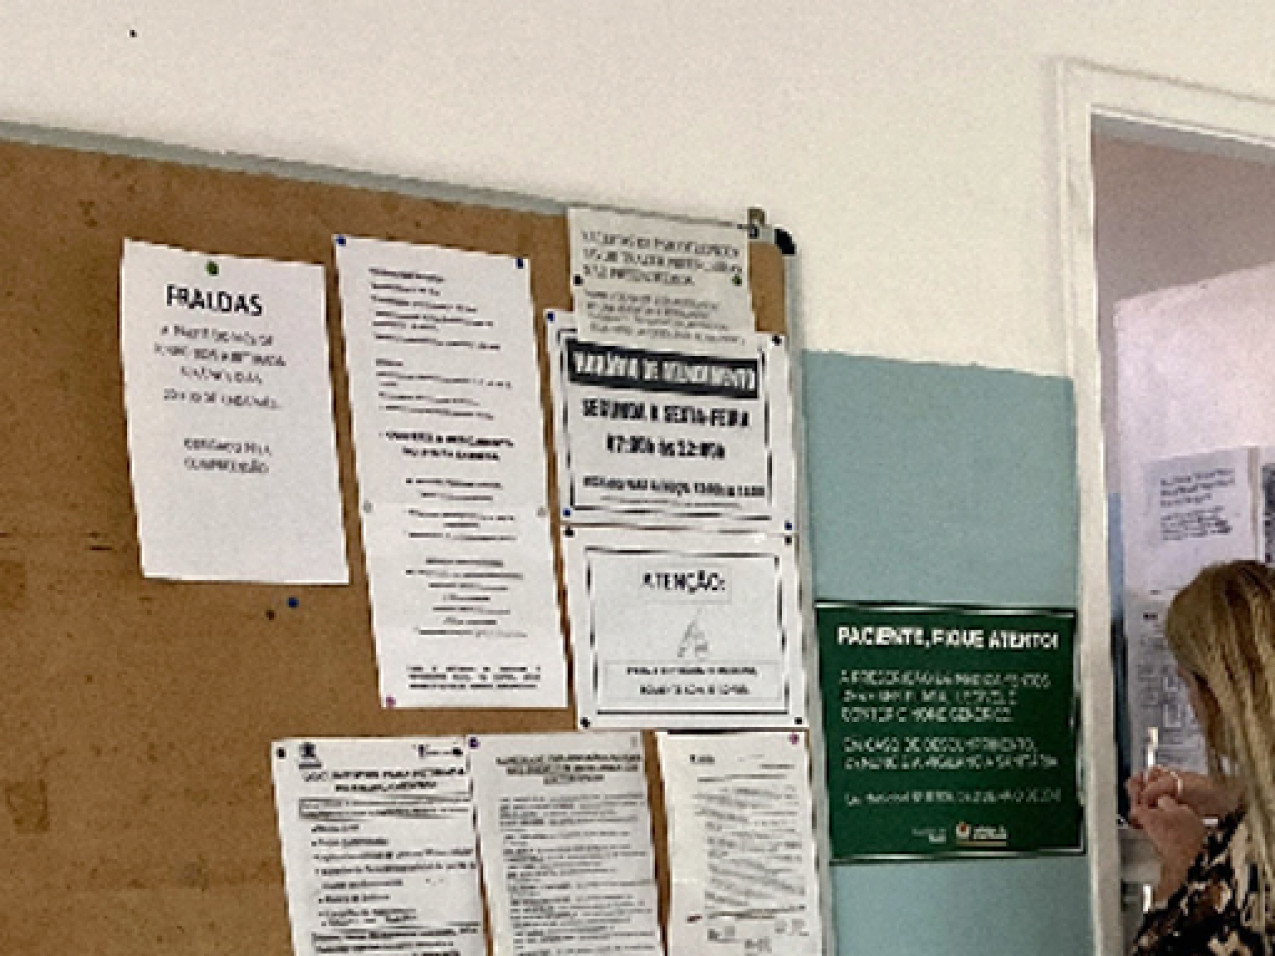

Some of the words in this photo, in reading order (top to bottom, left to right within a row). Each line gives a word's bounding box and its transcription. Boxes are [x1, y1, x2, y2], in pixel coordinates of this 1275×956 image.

[166, 283, 263, 317] FRALDAS
[582, 398, 648, 422] SEGUNDA
[664, 404, 750, 427] SEXTA-FEIRA
[641, 569, 727, 595] ATENÇÃO:
[836, 625, 932, 650] PACIENTE,
[932, 628, 986, 650] FIQUE
[988, 630, 1061, 650] ATENTO!
